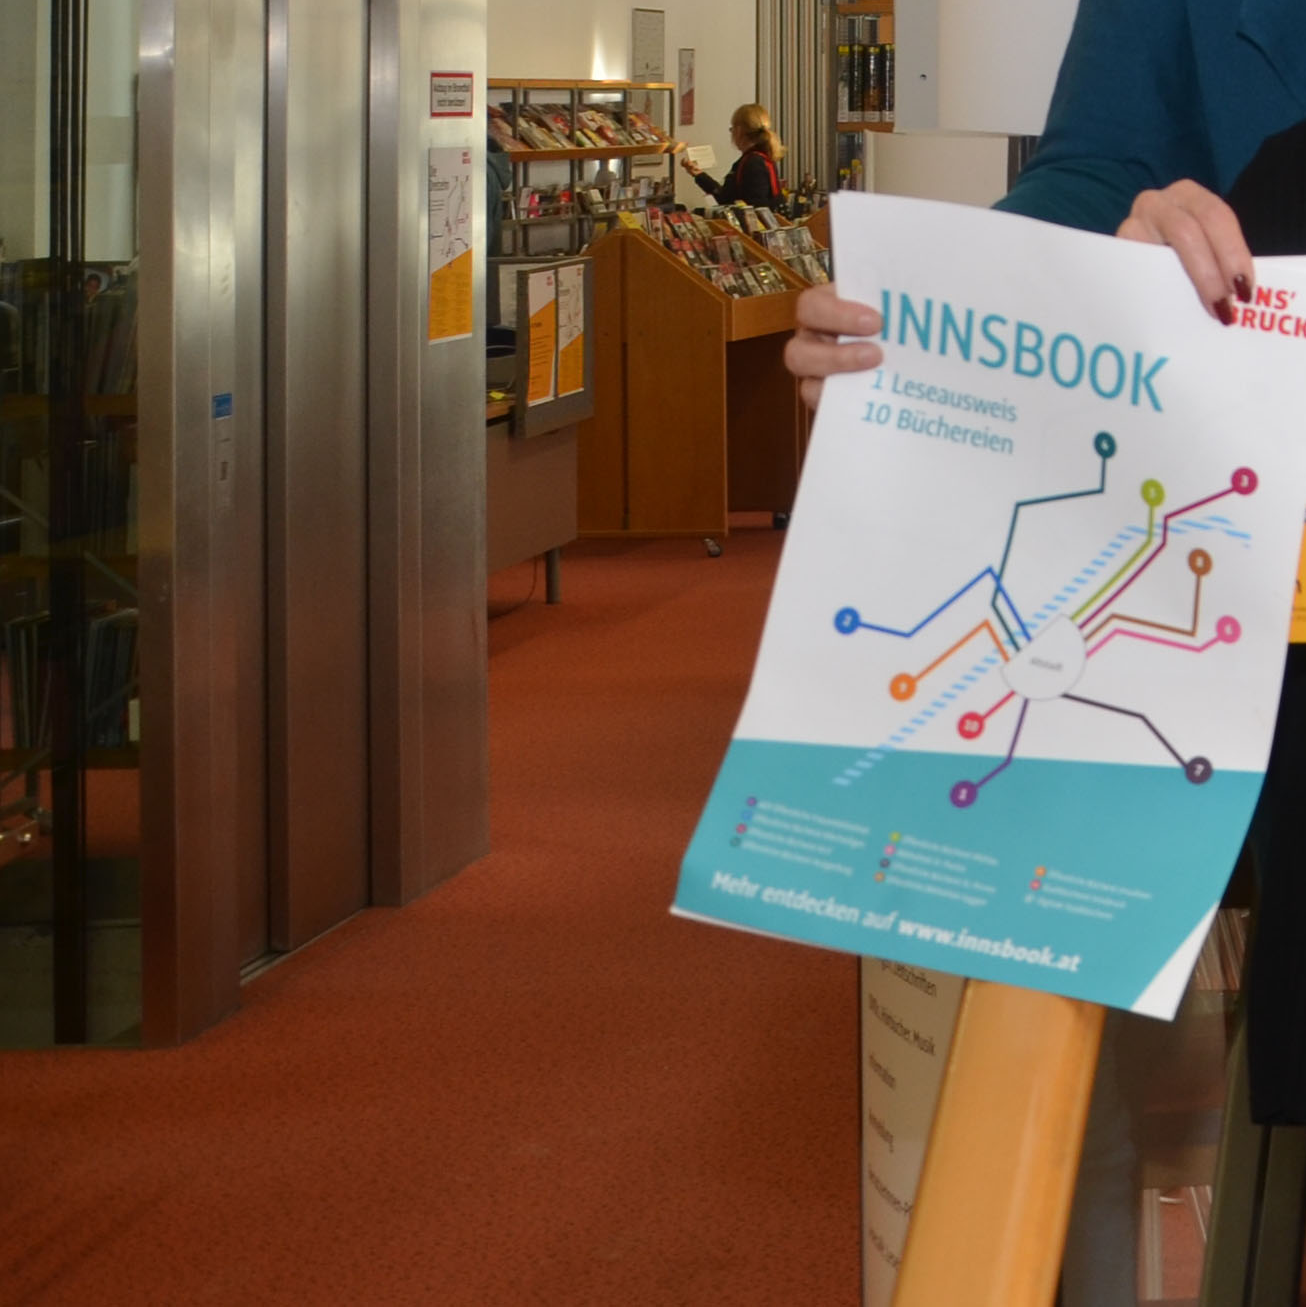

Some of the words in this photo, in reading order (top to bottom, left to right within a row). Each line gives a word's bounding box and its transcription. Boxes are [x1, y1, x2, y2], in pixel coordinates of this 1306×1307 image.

[880, 289, 1169, 412] INNSBOOK
[860, 397, 893, 427] 10
[895, 405, 1017, 455] Büchereien
[869, 366, 884, 391] 1
[890, 371, 1021, 423] Leseausweis
[709, 869, 761, 900] Mehr
[760, 880, 862, 925] entdecken
[860, 904, 896, 932] auf
[895, 912, 1082, 978] www.innsbook.at
